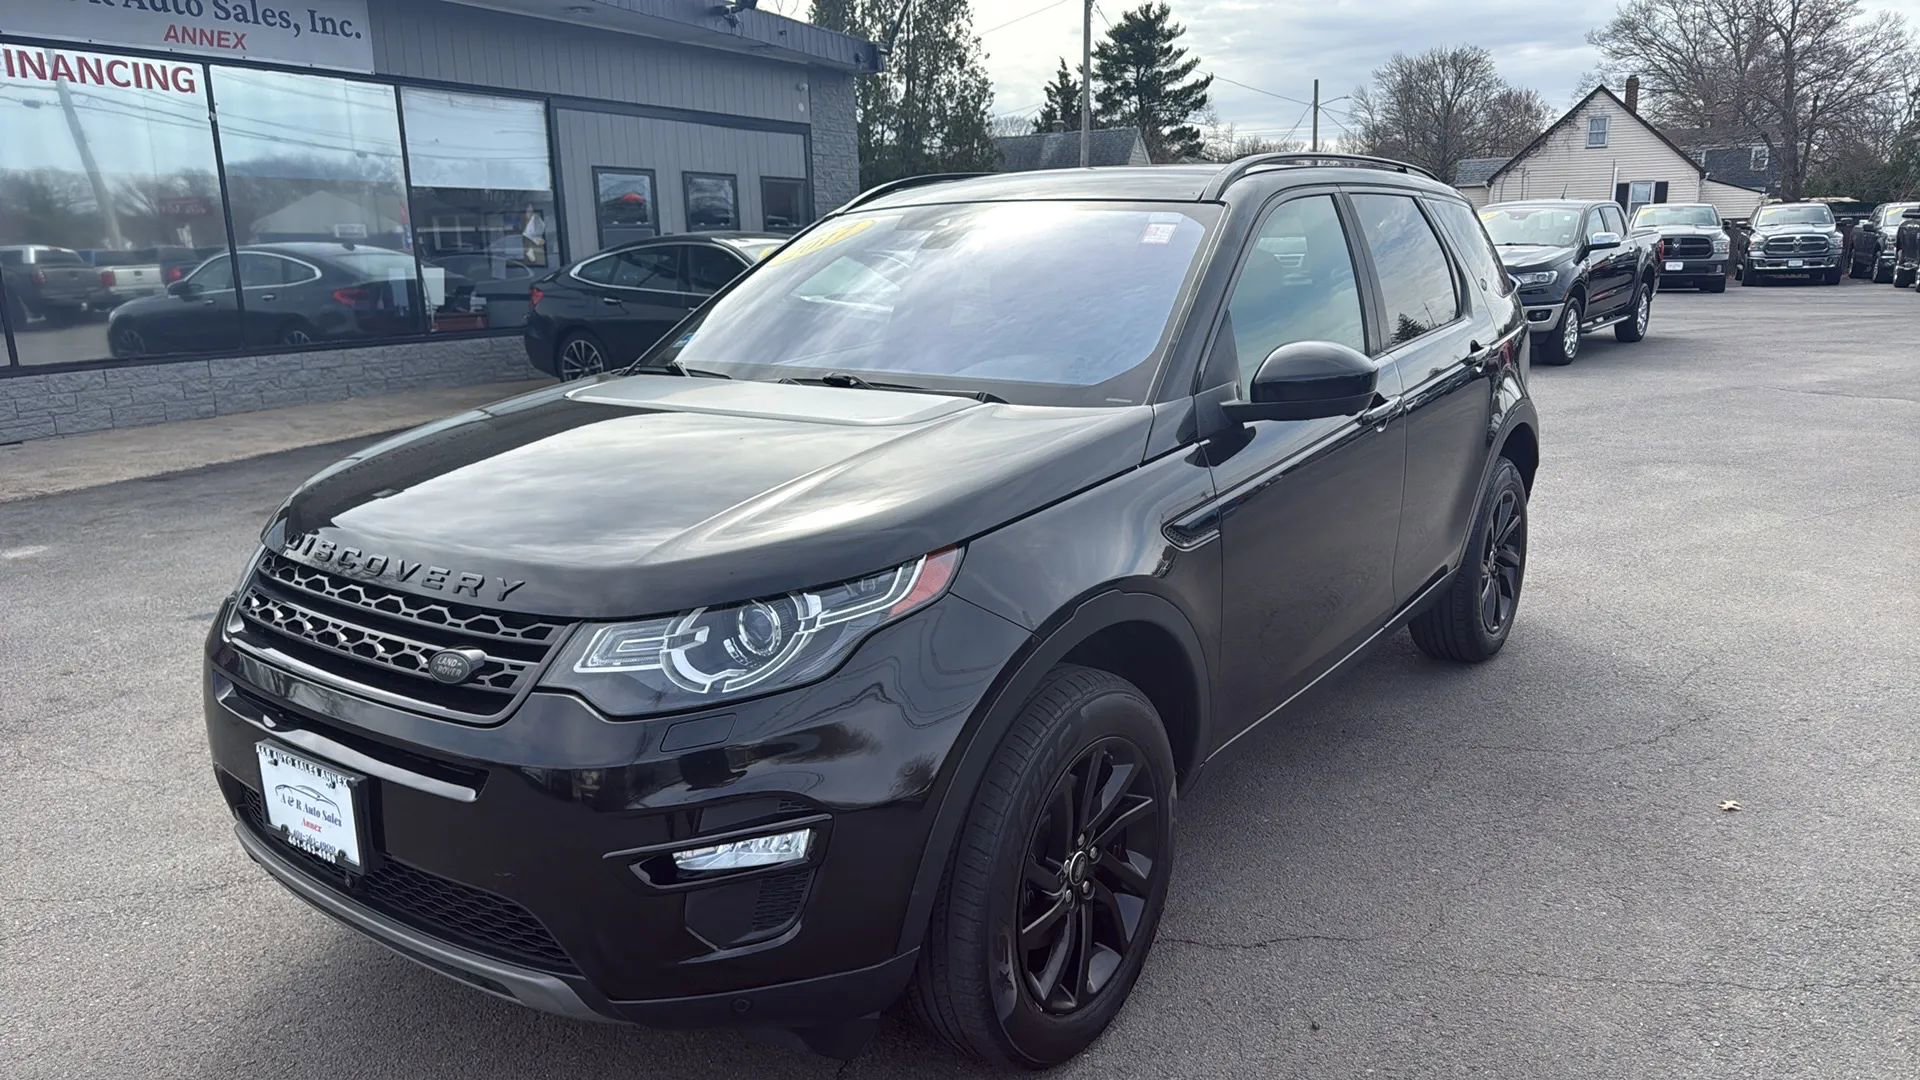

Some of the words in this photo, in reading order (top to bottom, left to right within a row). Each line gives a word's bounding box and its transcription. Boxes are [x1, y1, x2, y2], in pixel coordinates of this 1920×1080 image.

[163, 23, 247, 50] ANNEX
[213, 0, 301, 38] Sales,
[307, 9, 362, 39] Inc.
[2, 48, 196, 93] INANCING
[284, 532, 526, 602] DISCOVERY
[303, 803, 321, 818] Auto
